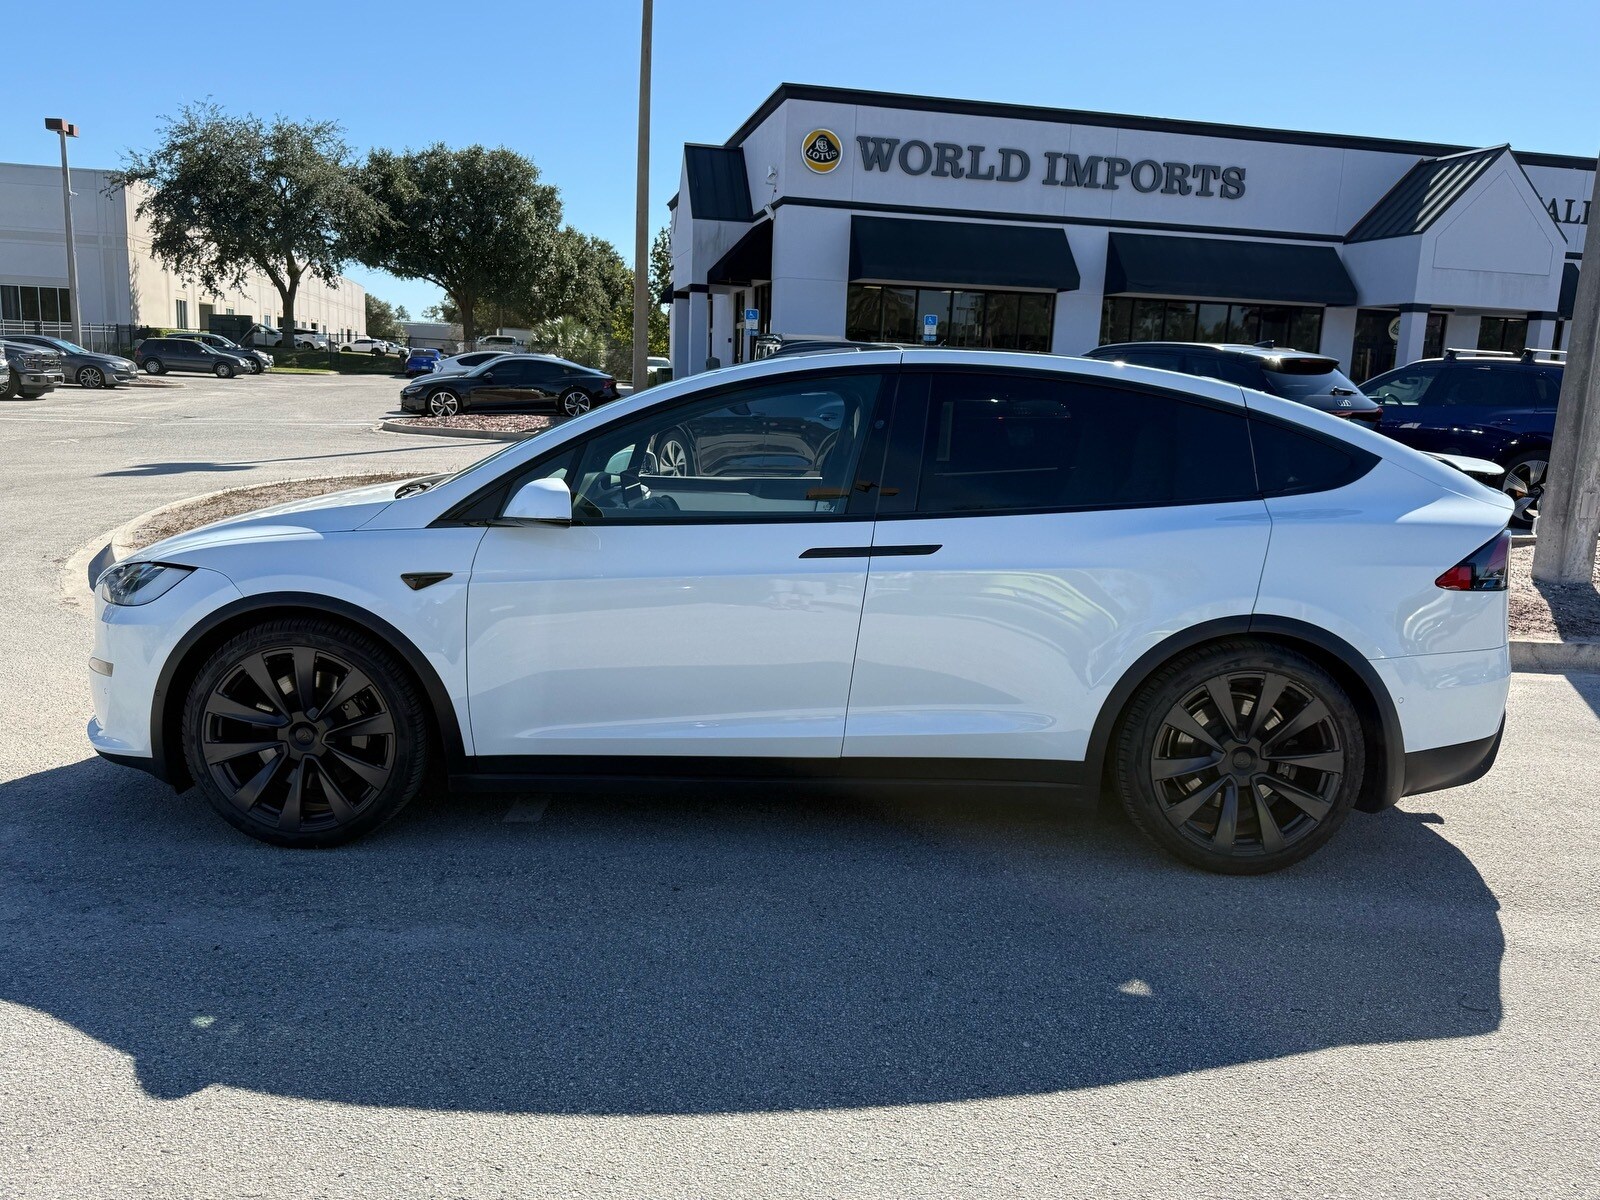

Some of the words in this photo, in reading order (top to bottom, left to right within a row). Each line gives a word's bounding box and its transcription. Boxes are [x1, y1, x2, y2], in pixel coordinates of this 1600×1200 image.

[807, 148, 838, 161] LOTUS
[856, 136, 1031, 183] WORLD
[1042, 151, 1246, 200] IMPORTS
